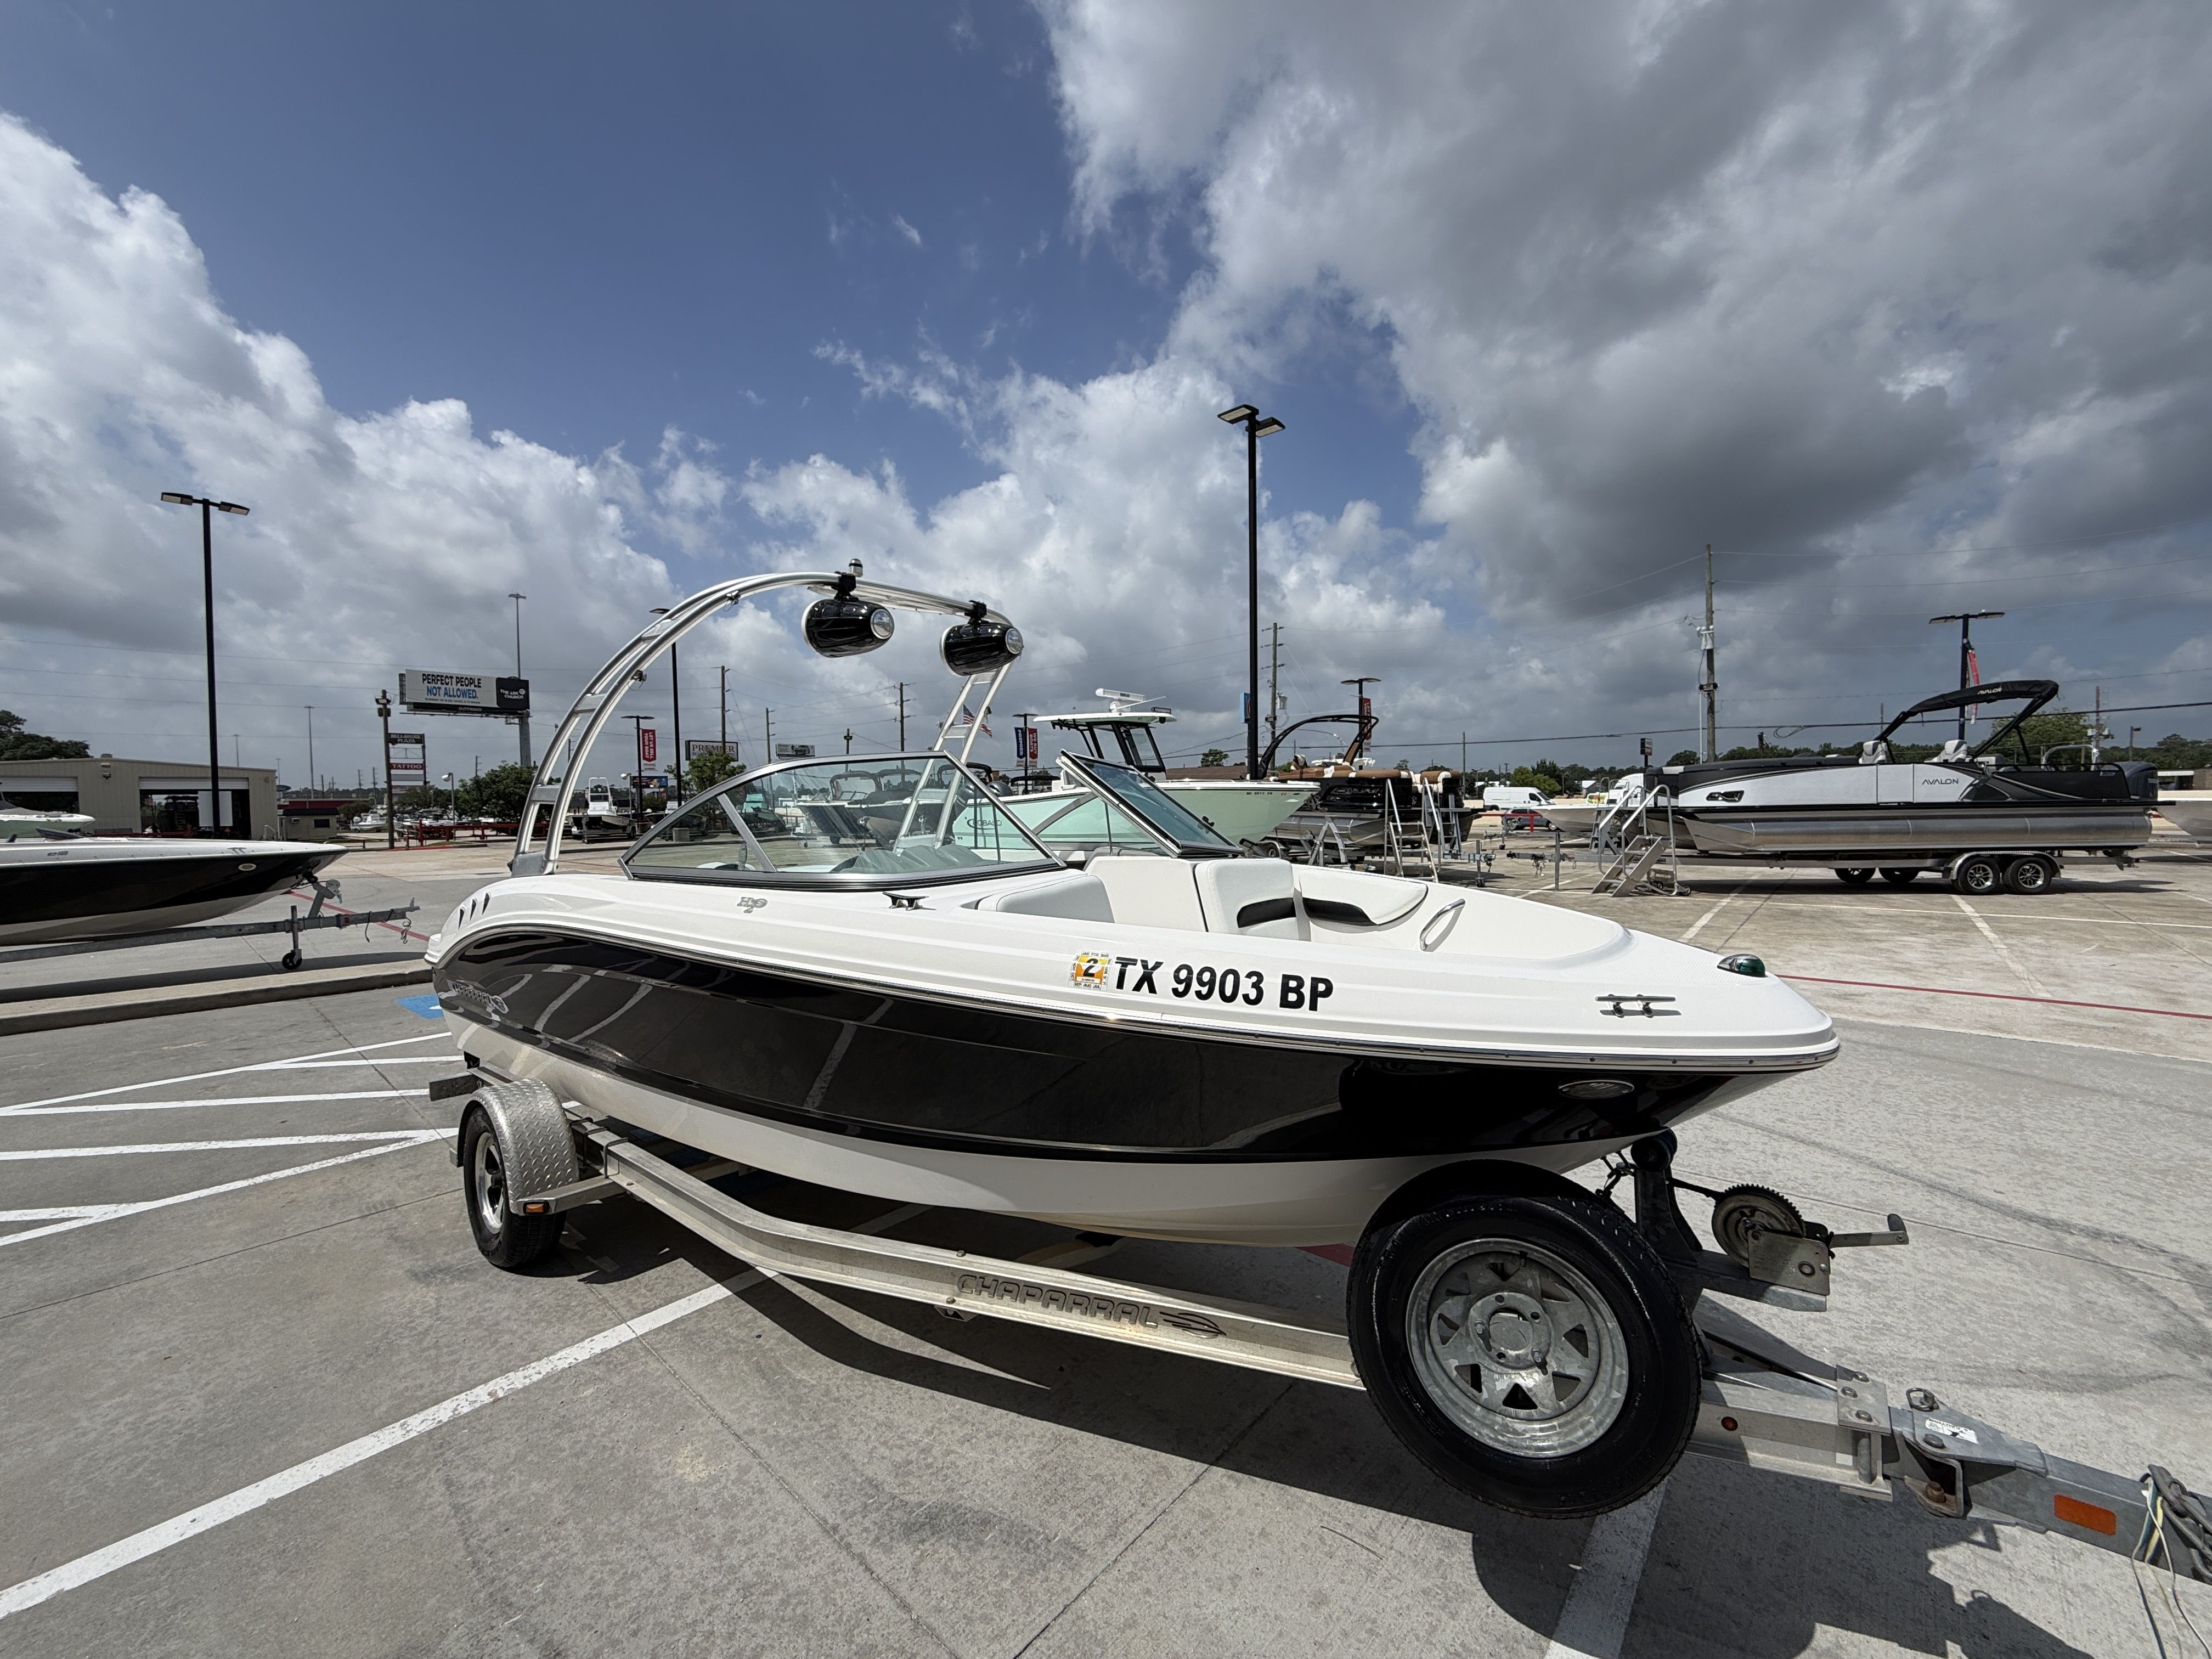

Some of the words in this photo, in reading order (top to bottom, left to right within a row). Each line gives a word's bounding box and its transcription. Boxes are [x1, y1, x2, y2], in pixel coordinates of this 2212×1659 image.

[422, 673, 454, 686] PERFECT
[456, 676, 482, 688] PEOPLE
[427, 686, 441, 697] NOT
[443, 687, 478, 699] ALLOWED.
[1977, 687, 2002, 695] AVALON
[1083, 958, 1099, 977] 2
[1115, 956, 1164, 995] TX
[1171, 964, 1263, 1006] 9903
[1279, 973, 1333, 1011] BP
[957, 1274, 1158, 1329] CHAPARRAL
